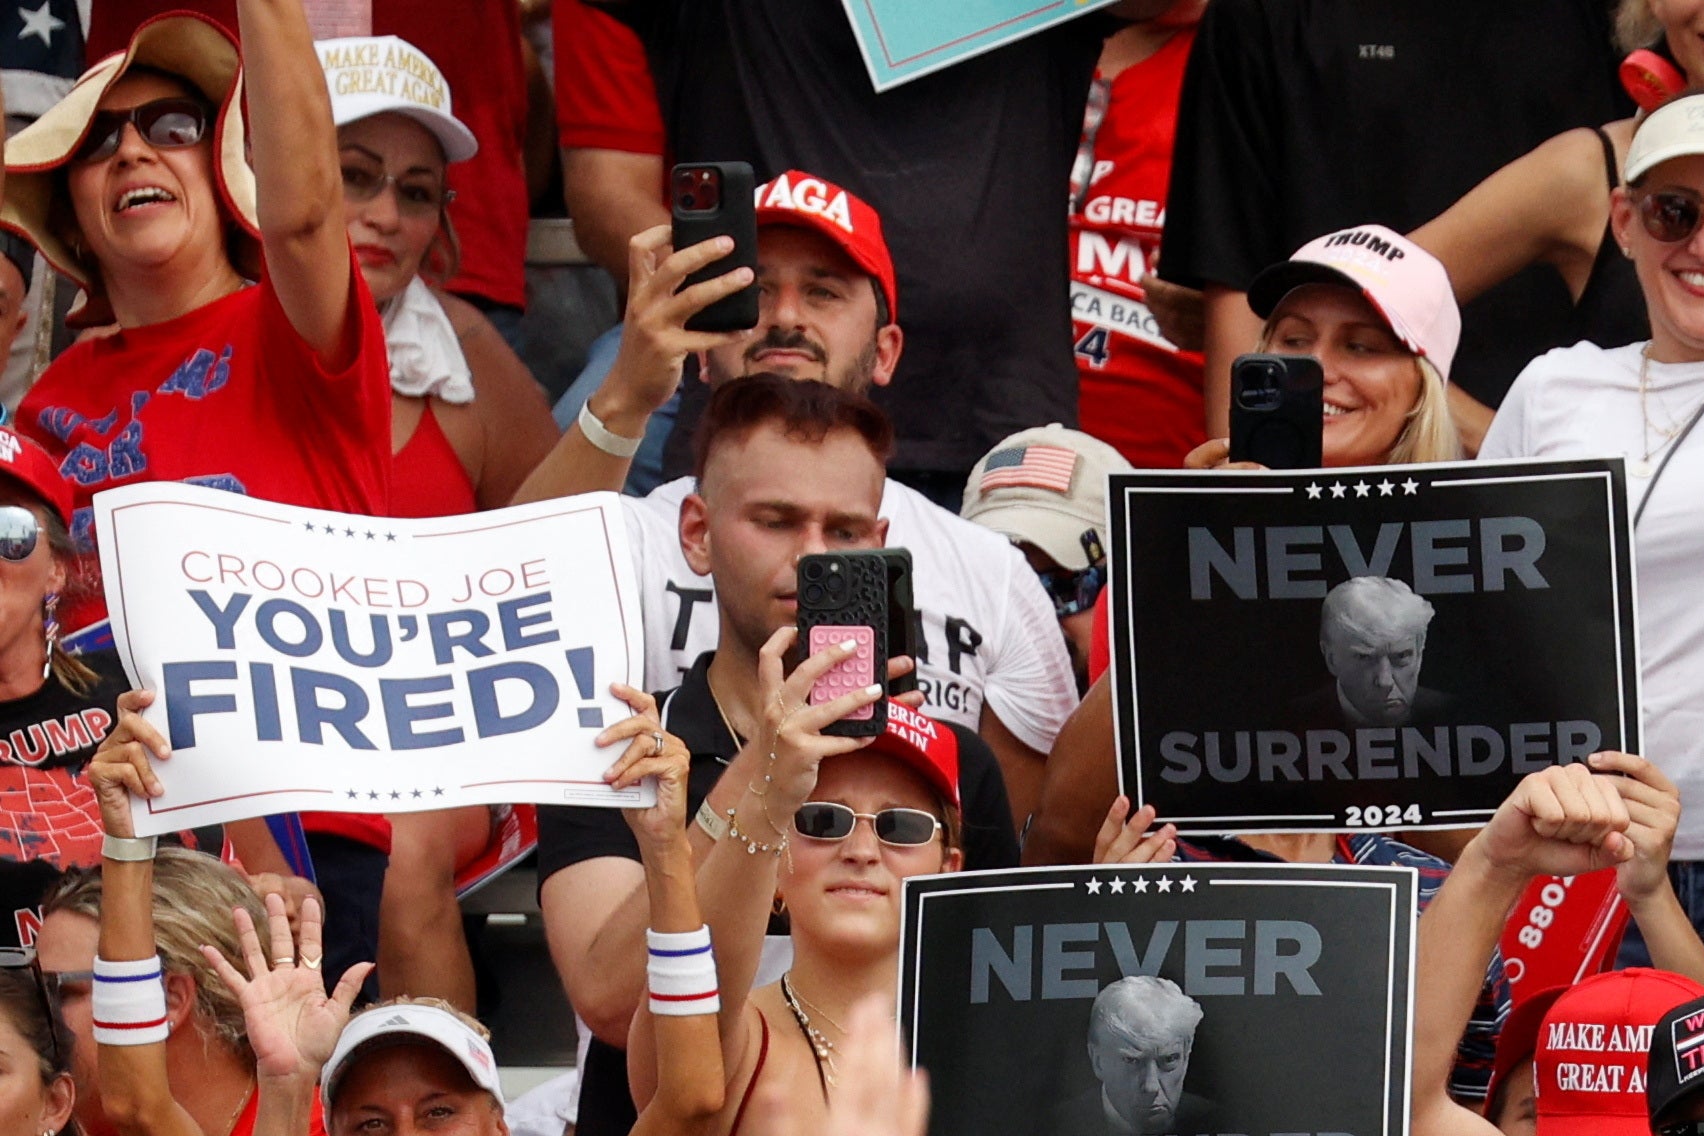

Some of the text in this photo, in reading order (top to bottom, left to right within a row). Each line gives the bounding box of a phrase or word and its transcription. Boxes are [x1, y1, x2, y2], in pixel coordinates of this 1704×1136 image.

[323, 44, 379, 70] MAKE
[335, 69, 398, 97] GREAT
[1324, 230, 1405, 262] TRUMP
[1110, 303, 1161, 336] BAC
[1187, 515, 1551, 600] NEVER
[180, 550, 551, 608] CROOKED JOE
[186, 589, 562, 669] YOU'RE
[162, 645, 605, 752] FIRED!
[887, 702, 938, 741] ERICA
[1159, 718, 1604, 785] SURRENDER
[1344, 803, 1423, 828] 2024
[969, 918, 1325, 1005] NEVER
[1546, 1022, 1605, 1052] MAKE
[1556, 1062, 1625, 1093] GREAT
